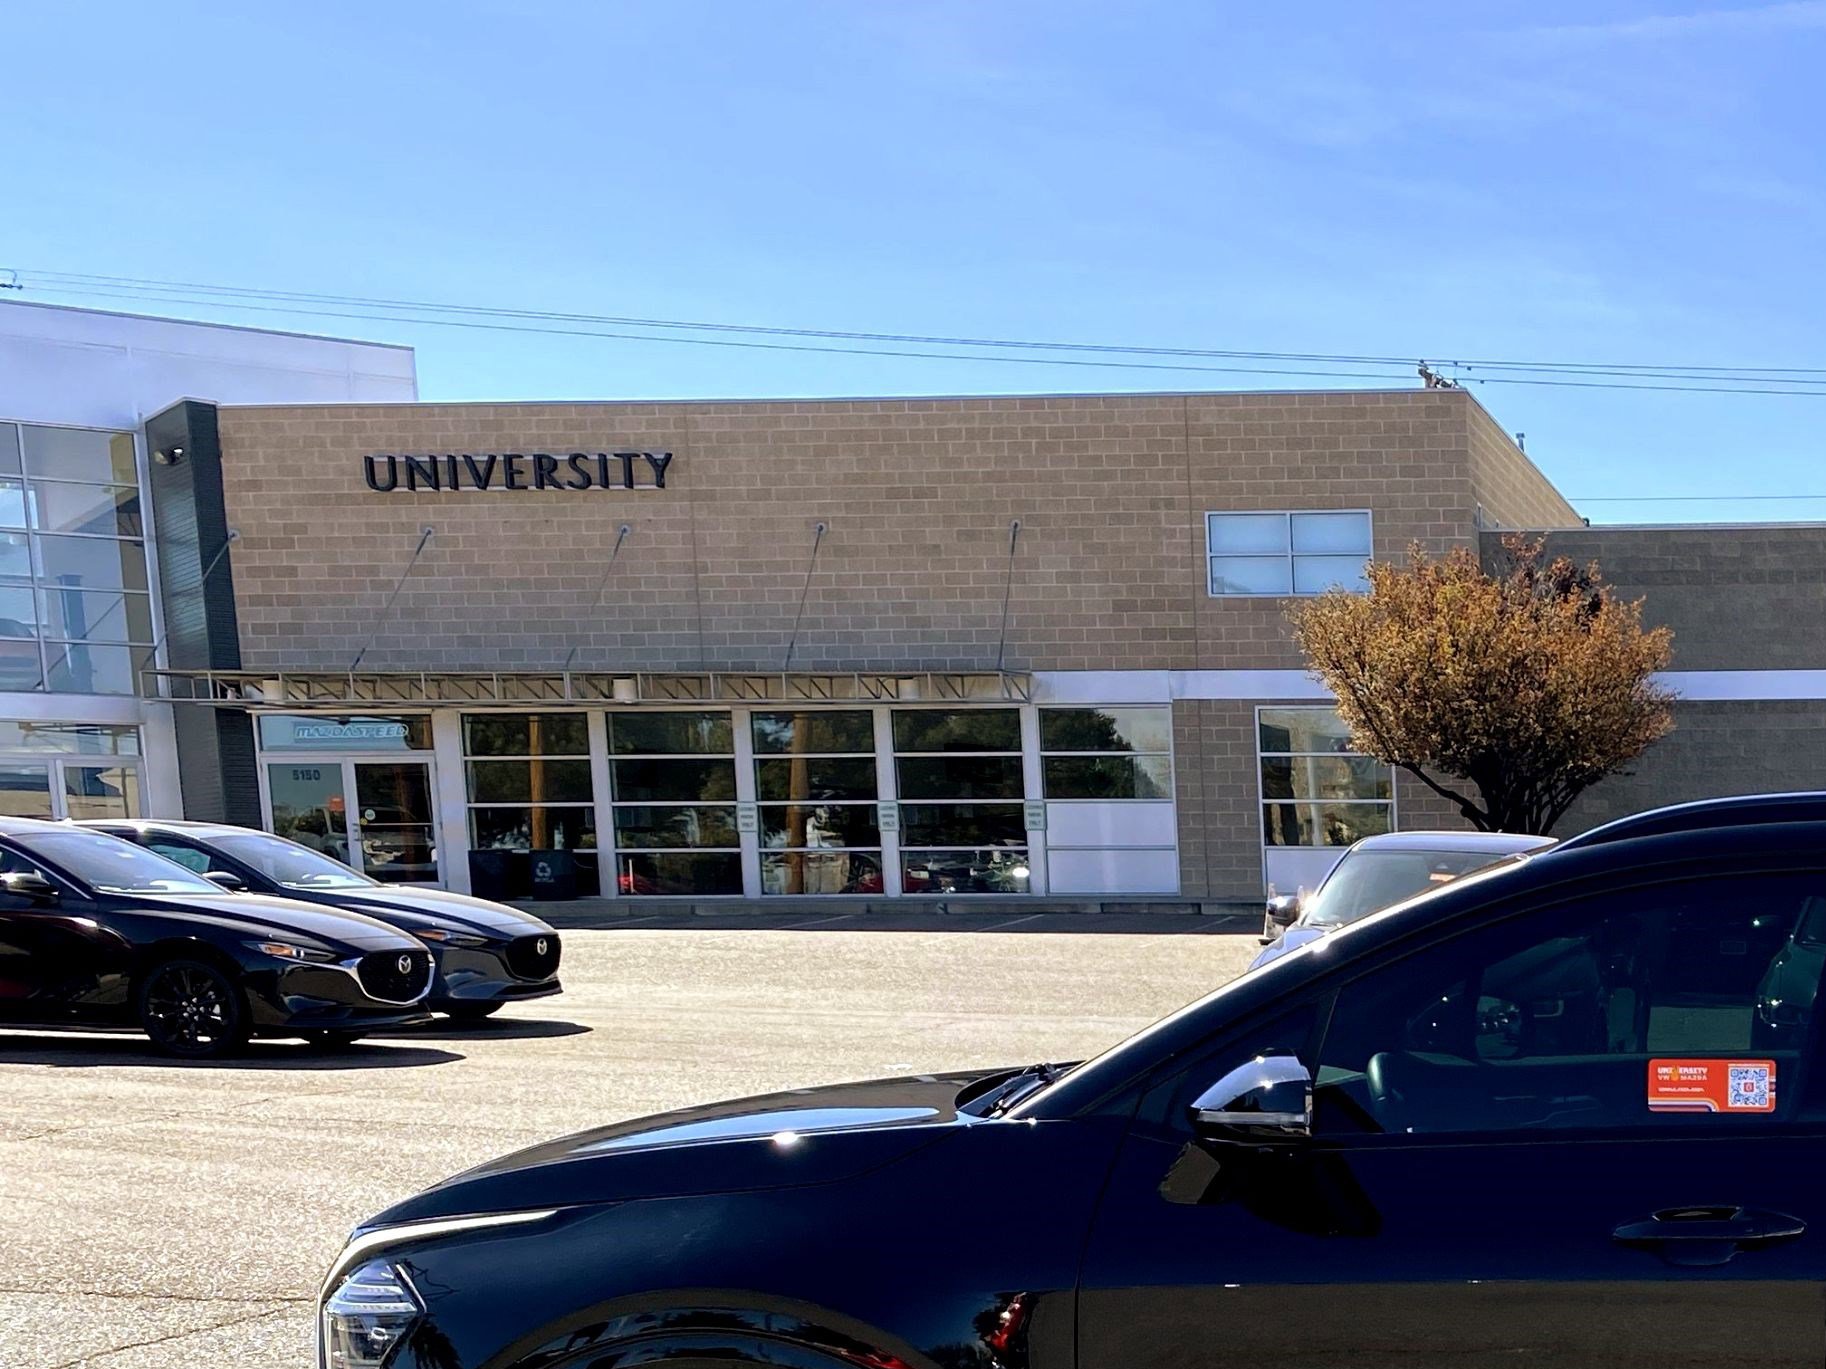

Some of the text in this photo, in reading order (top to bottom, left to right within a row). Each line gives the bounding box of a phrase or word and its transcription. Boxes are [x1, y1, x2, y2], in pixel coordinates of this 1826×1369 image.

[363, 451, 674, 492] UNIVERSITY
[295, 723, 409, 739] MAZDASPEED
[292, 769, 321, 781] 5150
